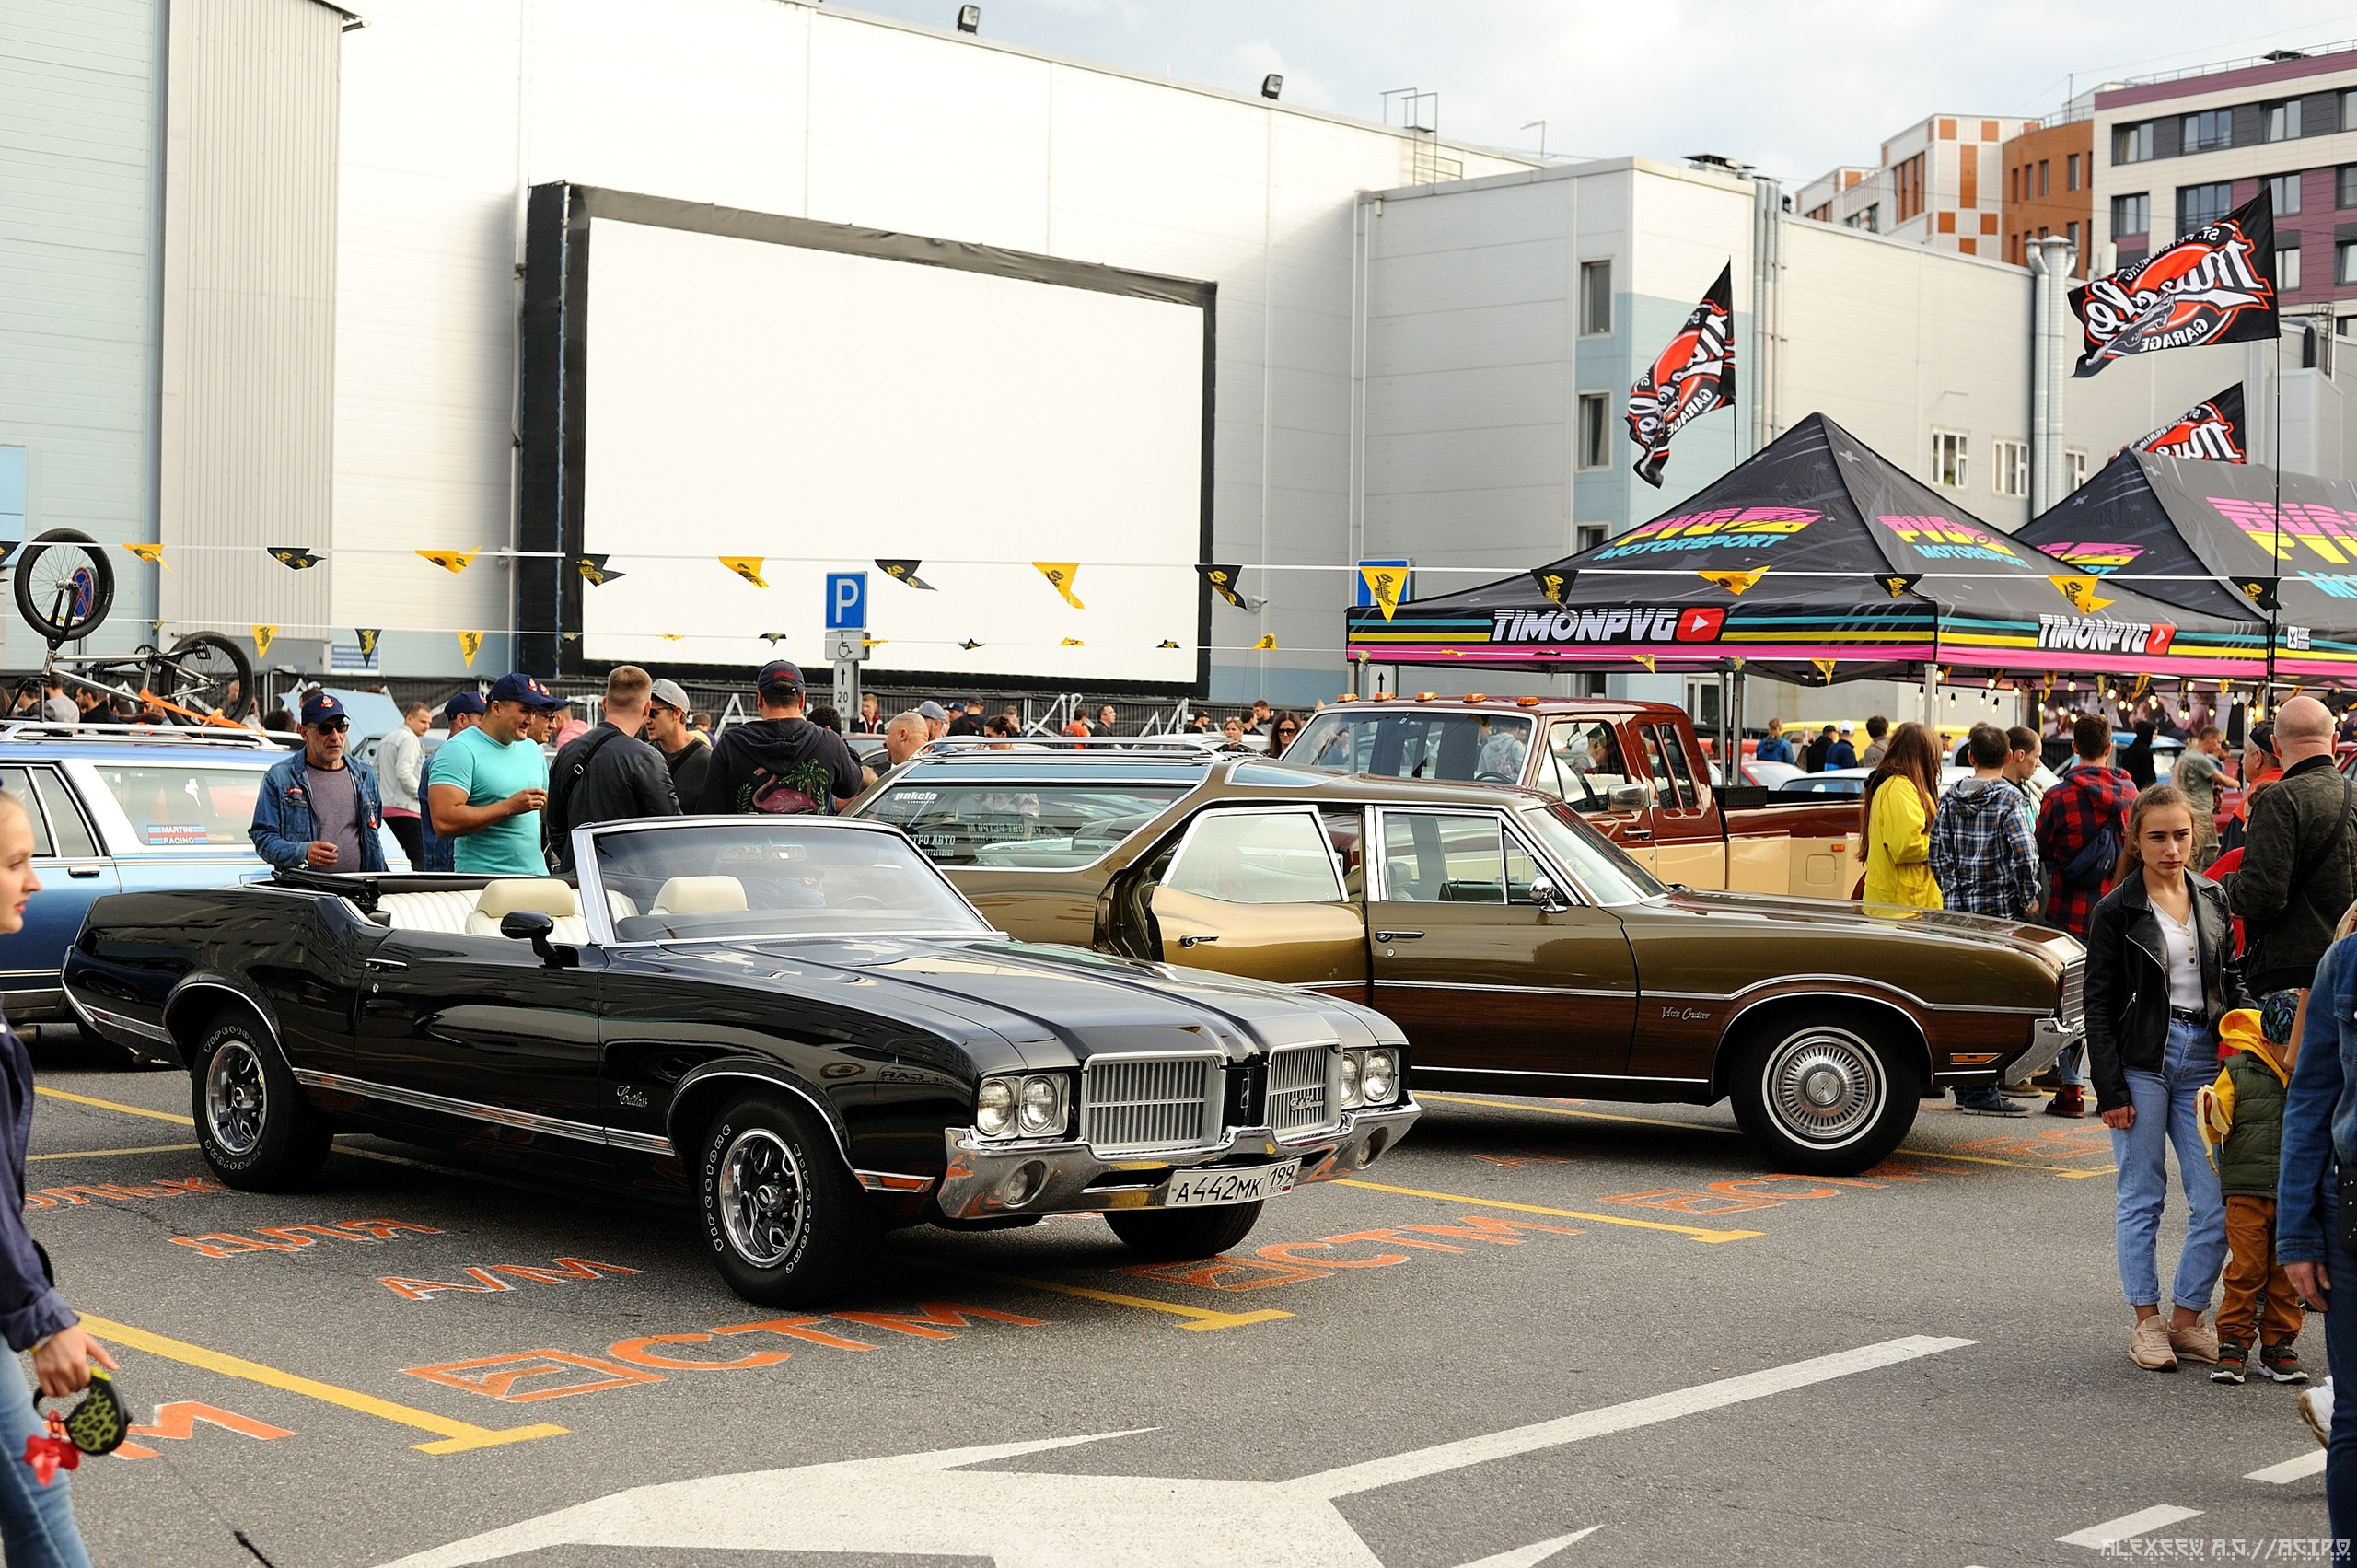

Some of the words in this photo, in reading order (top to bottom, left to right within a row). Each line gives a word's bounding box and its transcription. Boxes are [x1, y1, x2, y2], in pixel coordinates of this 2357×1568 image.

[1593, 534, 1789, 561] MOTORSPORT
[1913, 545, 2033, 570] MOTORSPORT
[835, 578, 859, 624] P
[1492, 608, 1678, 641] TIMONPVG
[2038, 614, 2151, 653] TIMONPVG
[837, 691, 849, 703] 20
[893, 791, 938, 801] pakelo
[163, 836, 195, 844] RACING
[932, 834, 956, 846] АВТО
[1662, 1006, 1680, 1018] Vista
[1681, 1007, 1711, 1020] Cruiser
[203, 1026, 262, 1057] Firestone
[616, 1085, 648, 1108] Cutlass
[703, 1123, 731, 1252] Firestone
[1175, 1175, 1264, 1202] А442МК
[1269, 1164, 1295, 1187] 199
[1269, 1185, 1283, 1194] RUS
[784, 1143, 812, 1275] Firestone
[169, 1217, 445, 1259] ДЛЯ
[377, 1256, 646, 1302] А/М
